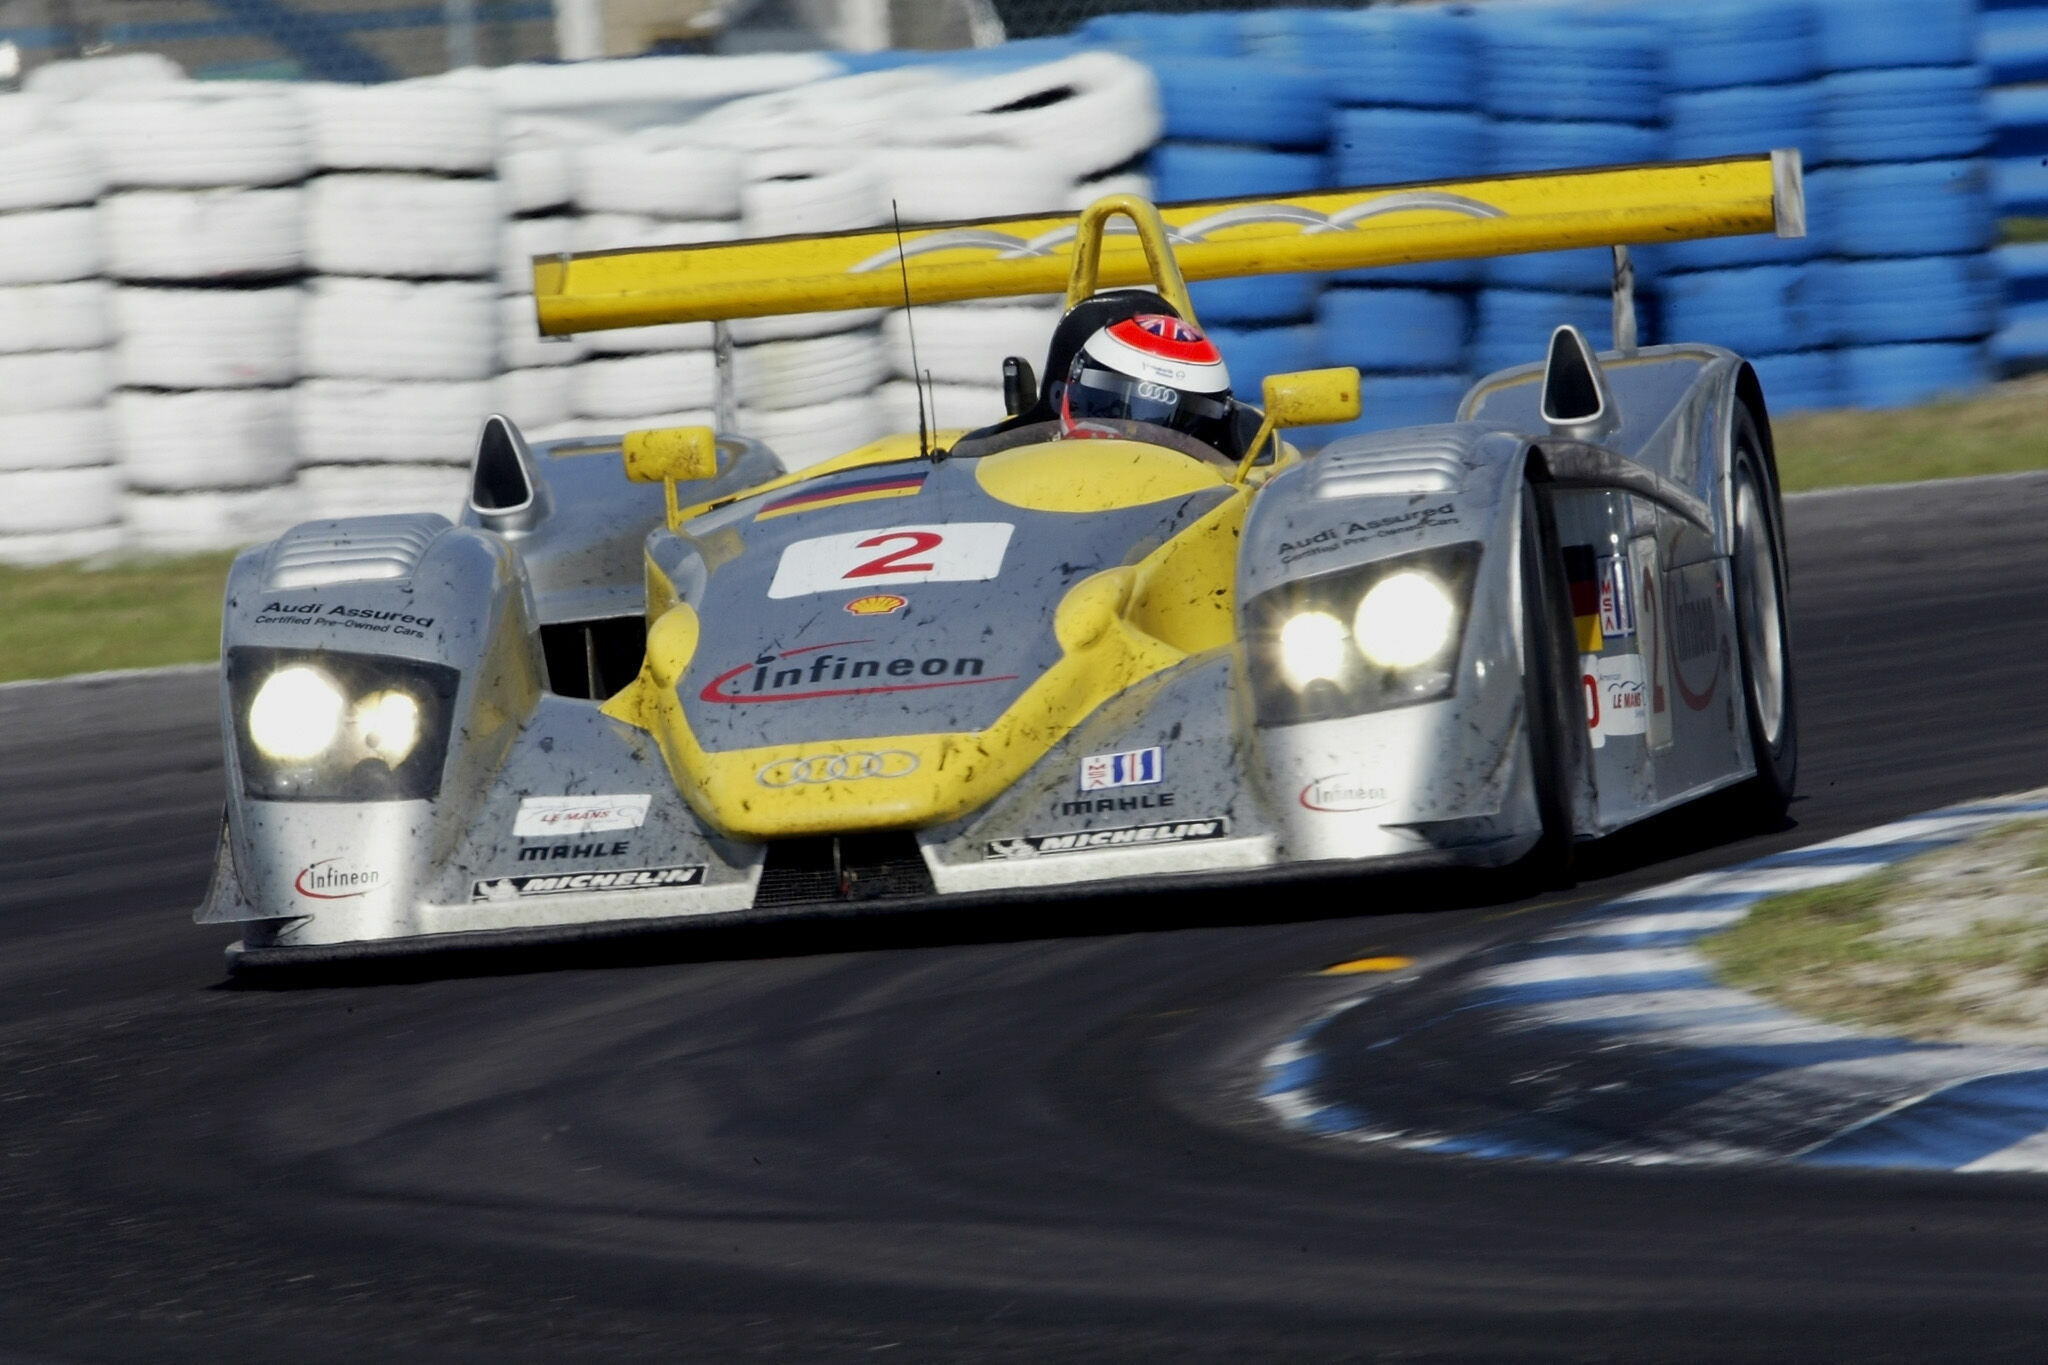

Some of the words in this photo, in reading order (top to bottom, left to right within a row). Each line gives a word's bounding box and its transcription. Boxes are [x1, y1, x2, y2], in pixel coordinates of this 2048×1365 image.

[1278, 528, 1337, 555] Audi
[1347, 503, 1455, 535] Assured
[841, 531, 943, 579] 2
[255, 614, 310, 625] Certified
[314, 617, 390, 633] Pre-Owned
[393, 625, 424, 639] Cars
[262, 601, 323, 614] Audi
[328, 604, 435, 628] Assured
[1613, 694, 1622, 709] LE
[540, 812, 560, 823] LE
[563, 809, 612, 821] MANS
[1062, 792, 1176, 816] MAHLE
[1039, 821, 1218, 850] MICHELIN
[518, 841, 630, 861] MAHLE
[522, 868, 697, 892] MICHELIN
